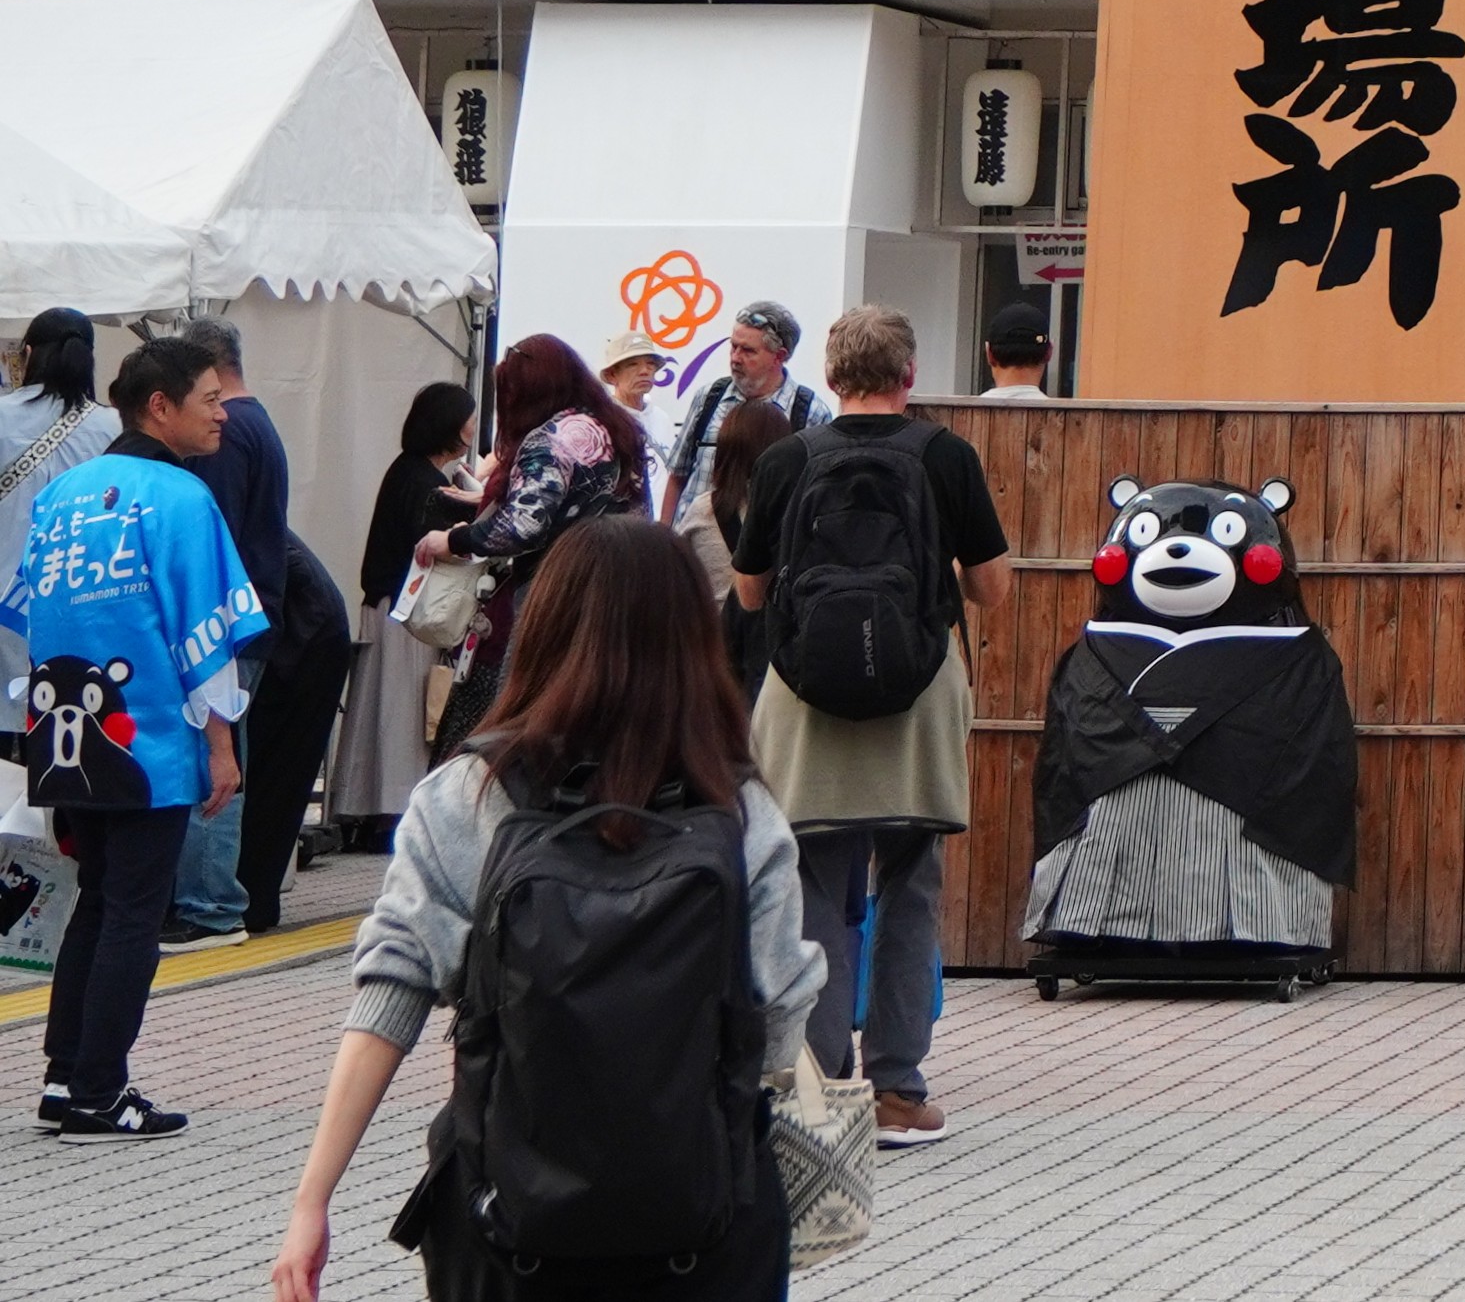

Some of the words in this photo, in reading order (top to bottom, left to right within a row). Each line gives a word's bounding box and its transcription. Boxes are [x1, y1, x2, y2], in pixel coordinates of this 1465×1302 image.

[1026, 245, 1069, 258] Re-entry
[1071, 246, 1086, 258] ga
[862, 618, 876, 677] DAKINE
